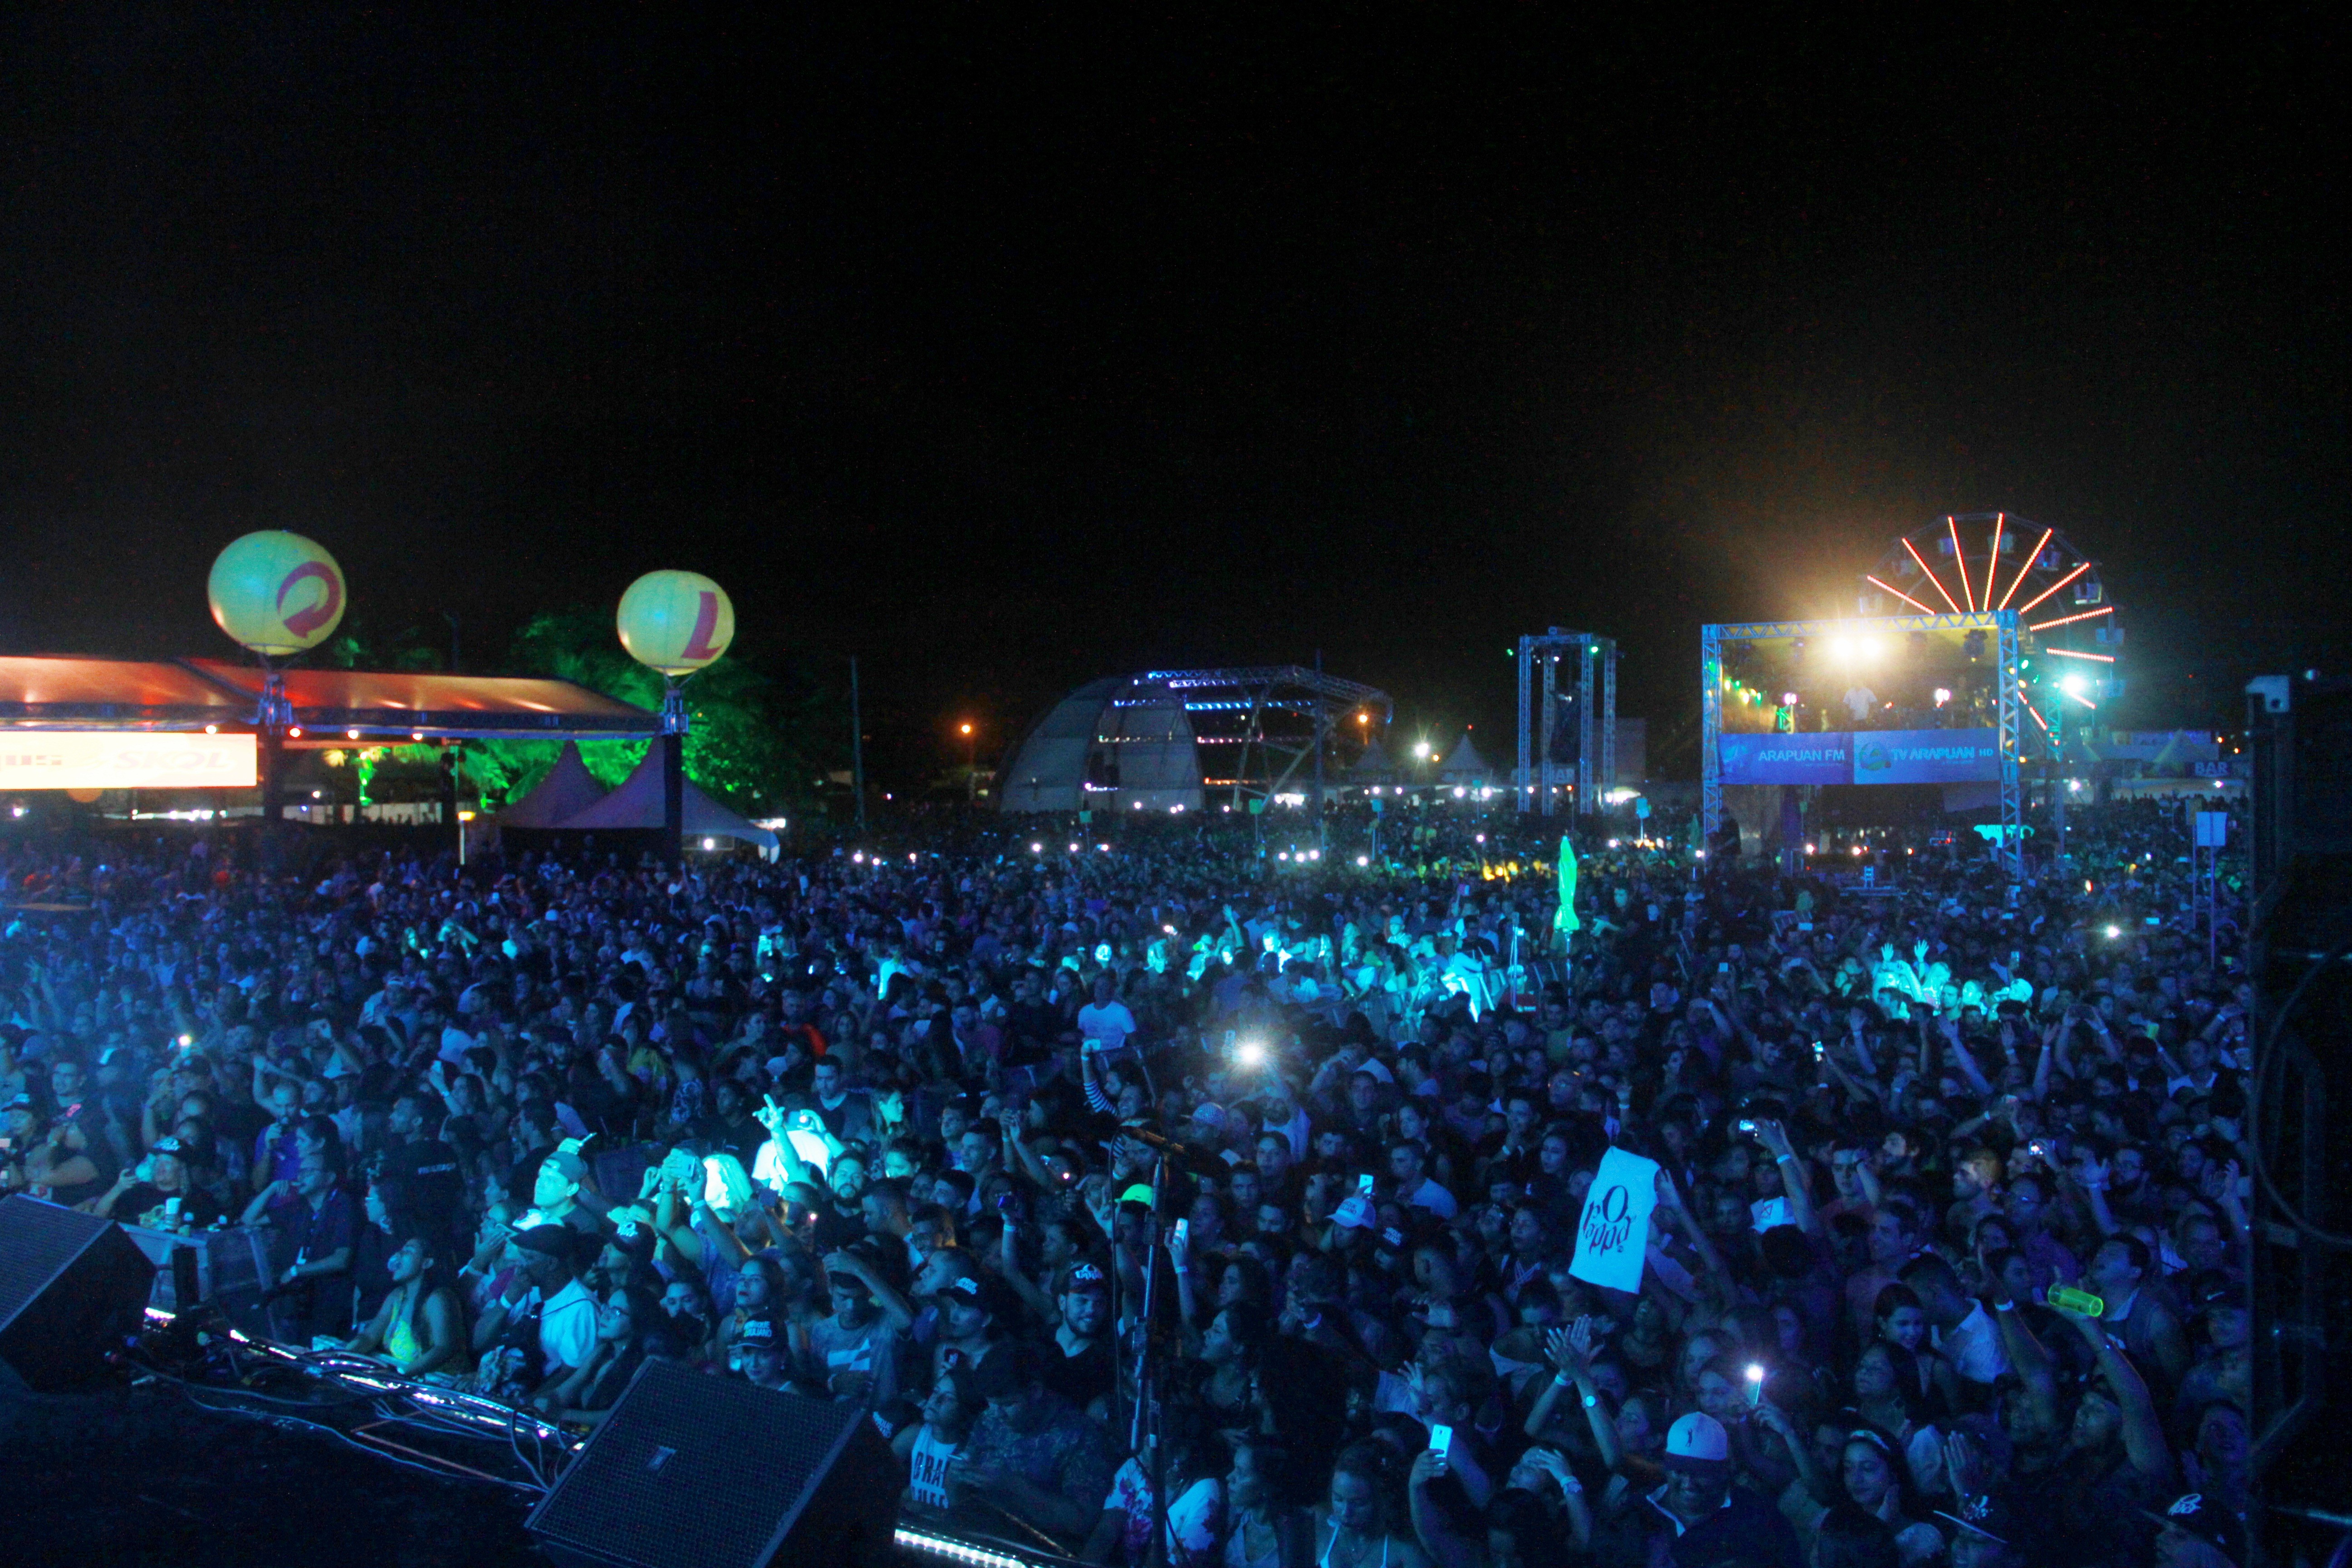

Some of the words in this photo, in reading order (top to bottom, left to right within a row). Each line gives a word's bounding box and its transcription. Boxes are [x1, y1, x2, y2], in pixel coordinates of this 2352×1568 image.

[681, 591, 723, 660] L
[115, 751, 230, 769] SKOL
[1759, 750, 1822, 761] ARAPUAN
[1825, 749, 1845, 760] FM
[1891, 749, 1907, 760] TV
[1910, 747, 1975, 760] ARAPUAN
[1979, 748, 1994, 757] HD
[2195, 762, 2228, 775] BAR
[1602, 1185, 1628, 1222] O
